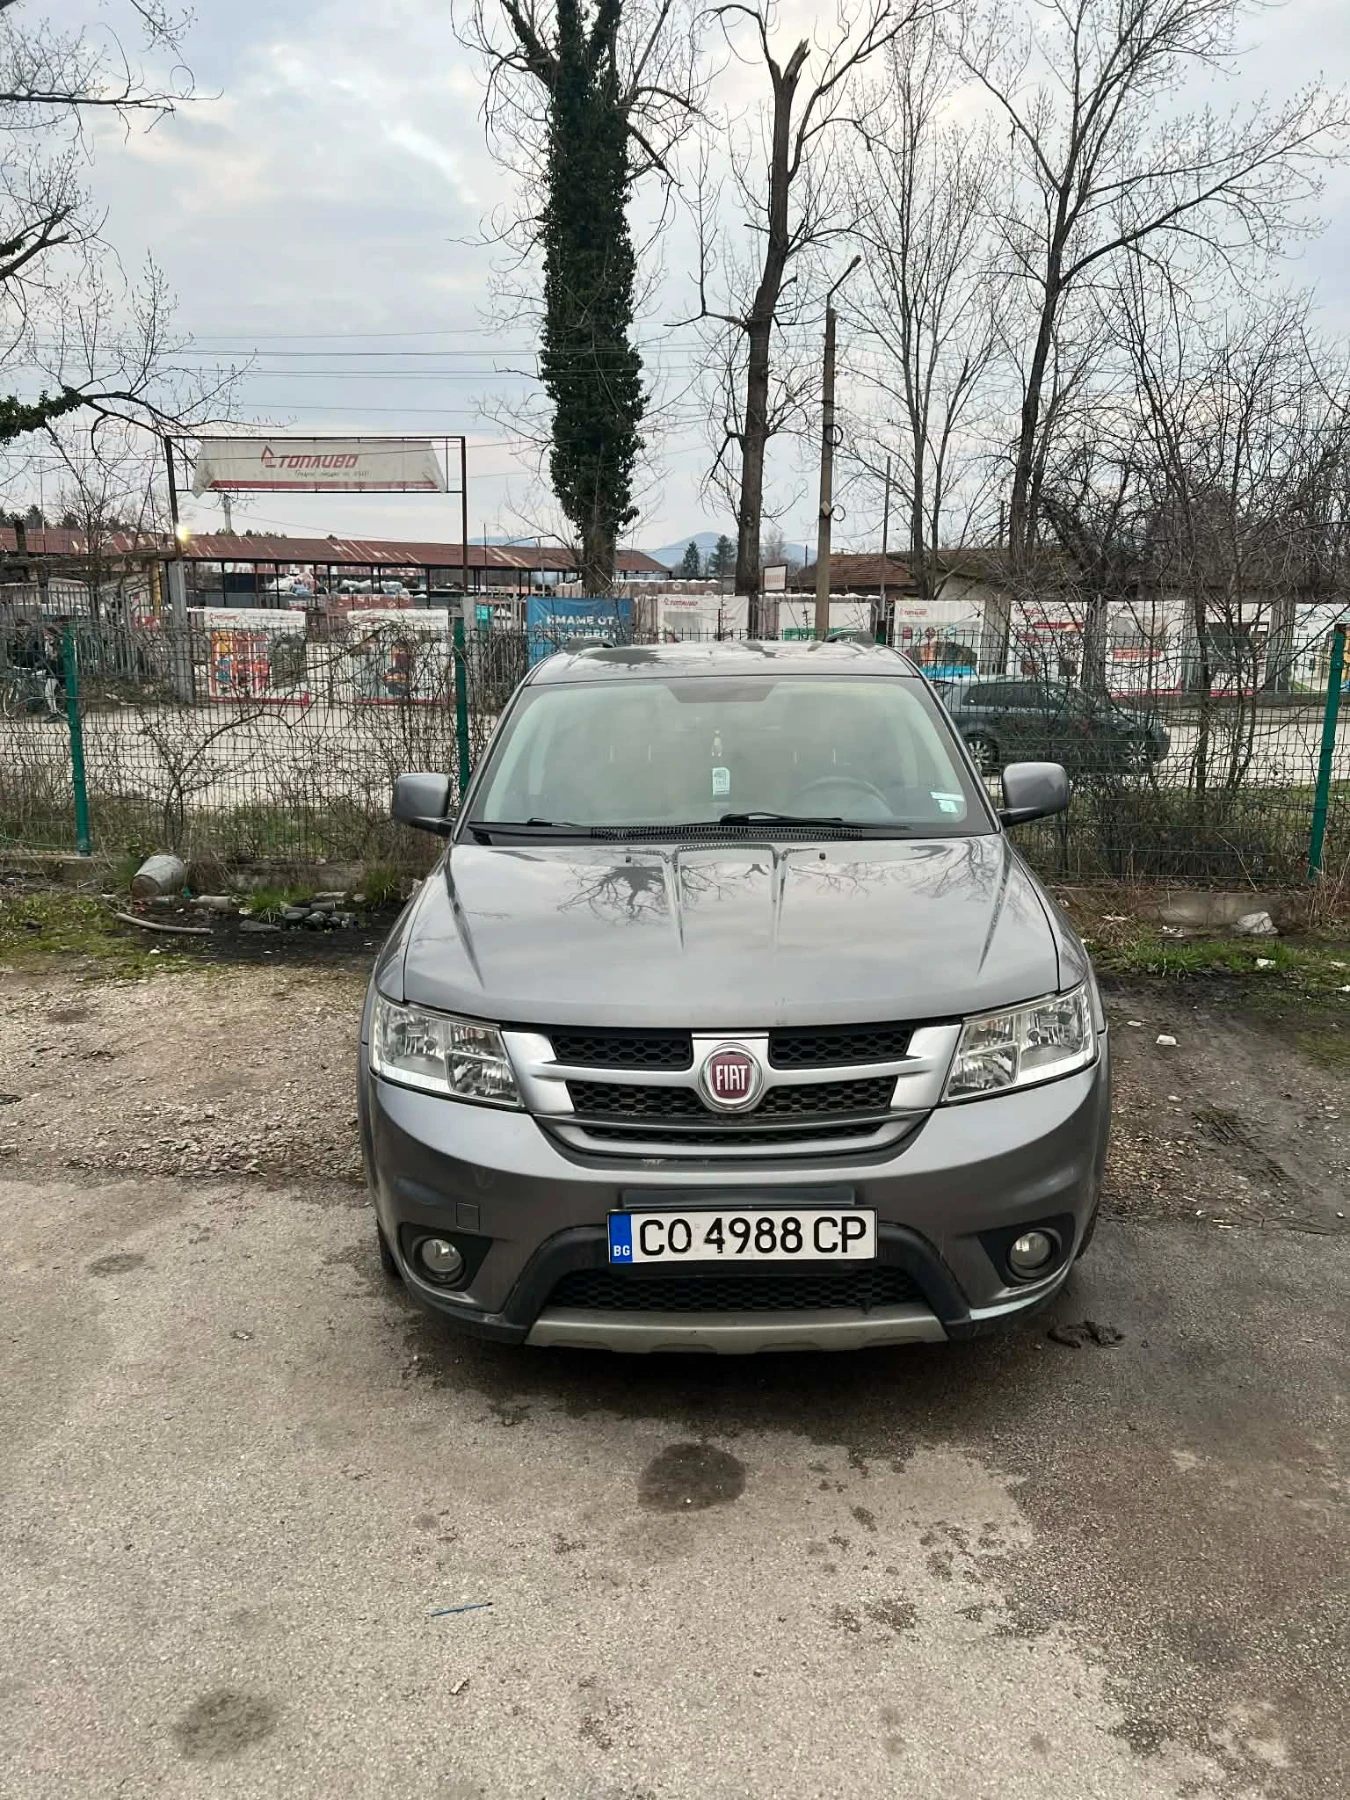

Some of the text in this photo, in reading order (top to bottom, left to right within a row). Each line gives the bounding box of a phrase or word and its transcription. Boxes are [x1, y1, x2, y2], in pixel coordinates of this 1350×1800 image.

[715, 1064, 748, 1091] FIAT
[639, 1215, 867, 1257] CO 4988 CP
[613, 1245, 631, 1257] BG
